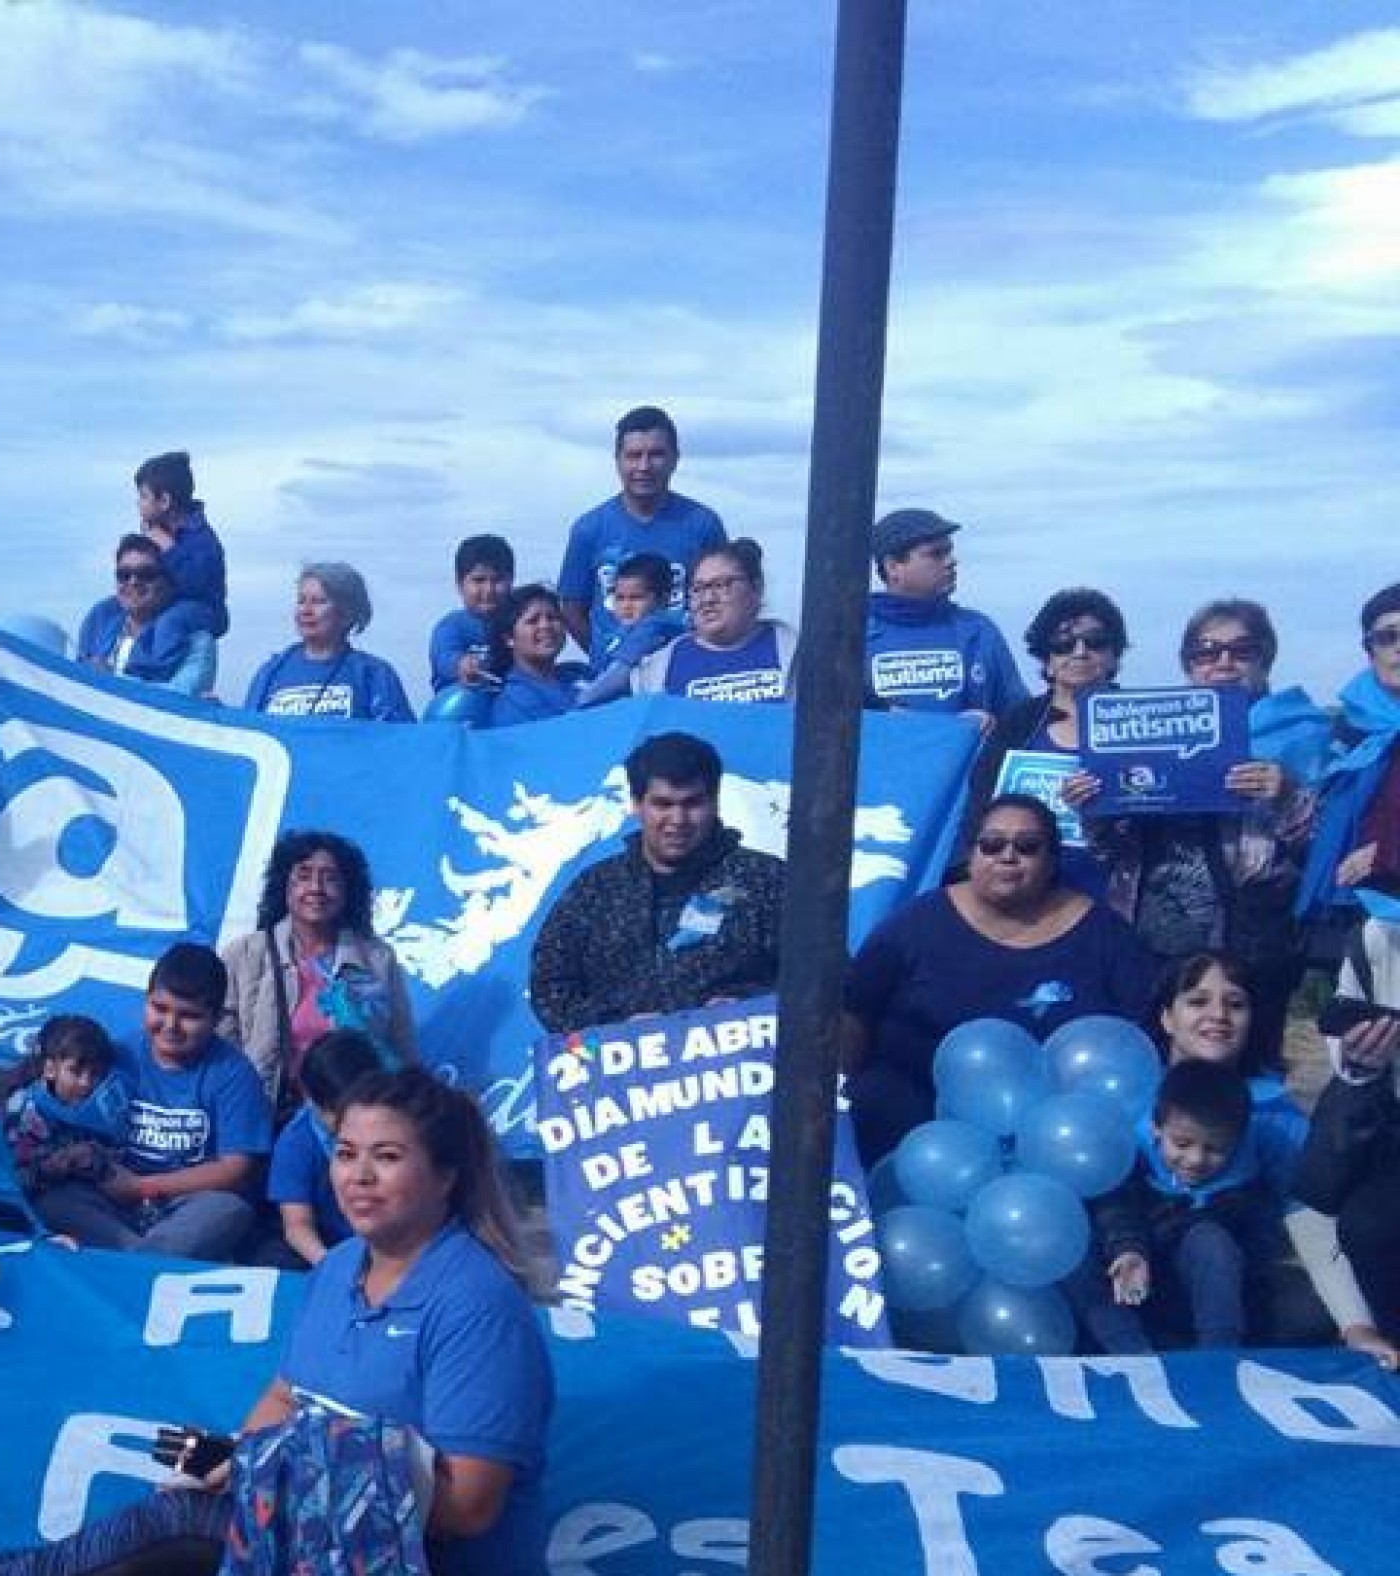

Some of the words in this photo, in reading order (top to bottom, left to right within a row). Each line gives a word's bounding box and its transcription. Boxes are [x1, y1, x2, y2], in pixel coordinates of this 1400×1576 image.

[1091, 713, 1215, 742] autismo
[547, 1052, 590, 1092] 2
[601, 1032, 670, 1075] DE
[681, 1015, 778, 1062] ABR
[582, 1142, 653, 1191] DE
